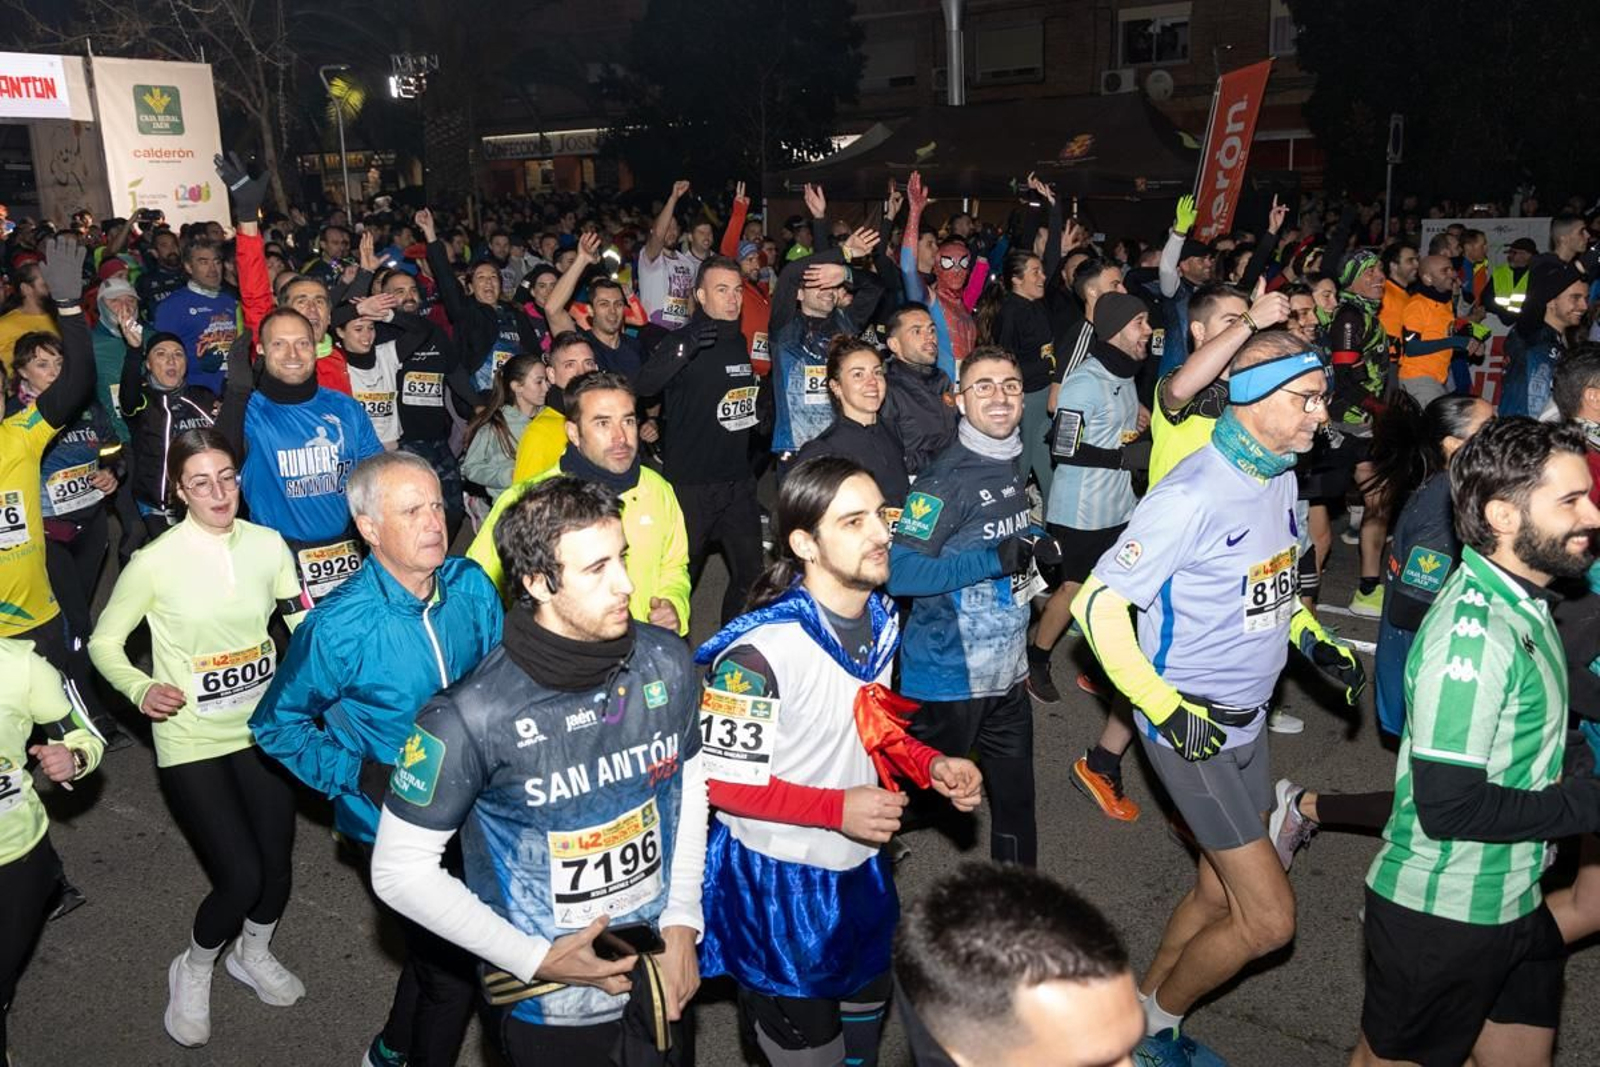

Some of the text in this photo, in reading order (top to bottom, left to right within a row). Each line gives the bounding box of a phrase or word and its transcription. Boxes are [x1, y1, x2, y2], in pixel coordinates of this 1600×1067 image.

[133, 148, 195, 159] calderón
[408, 381, 441, 394] 6373
[721, 398, 753, 417] 6768
[63, 426, 98, 444] NTÓN
[277, 445, 340, 478] RUNNERS
[0, 506, 20, 525] 6
[983, 508, 1032, 540] SAN ANT
[308, 554, 360, 580] 9926
[202, 656, 271, 693] 6600
[524, 730, 679, 807] SAN ANTÓN
[578, 831, 603, 851] 42
[561, 829, 658, 892] 7196
